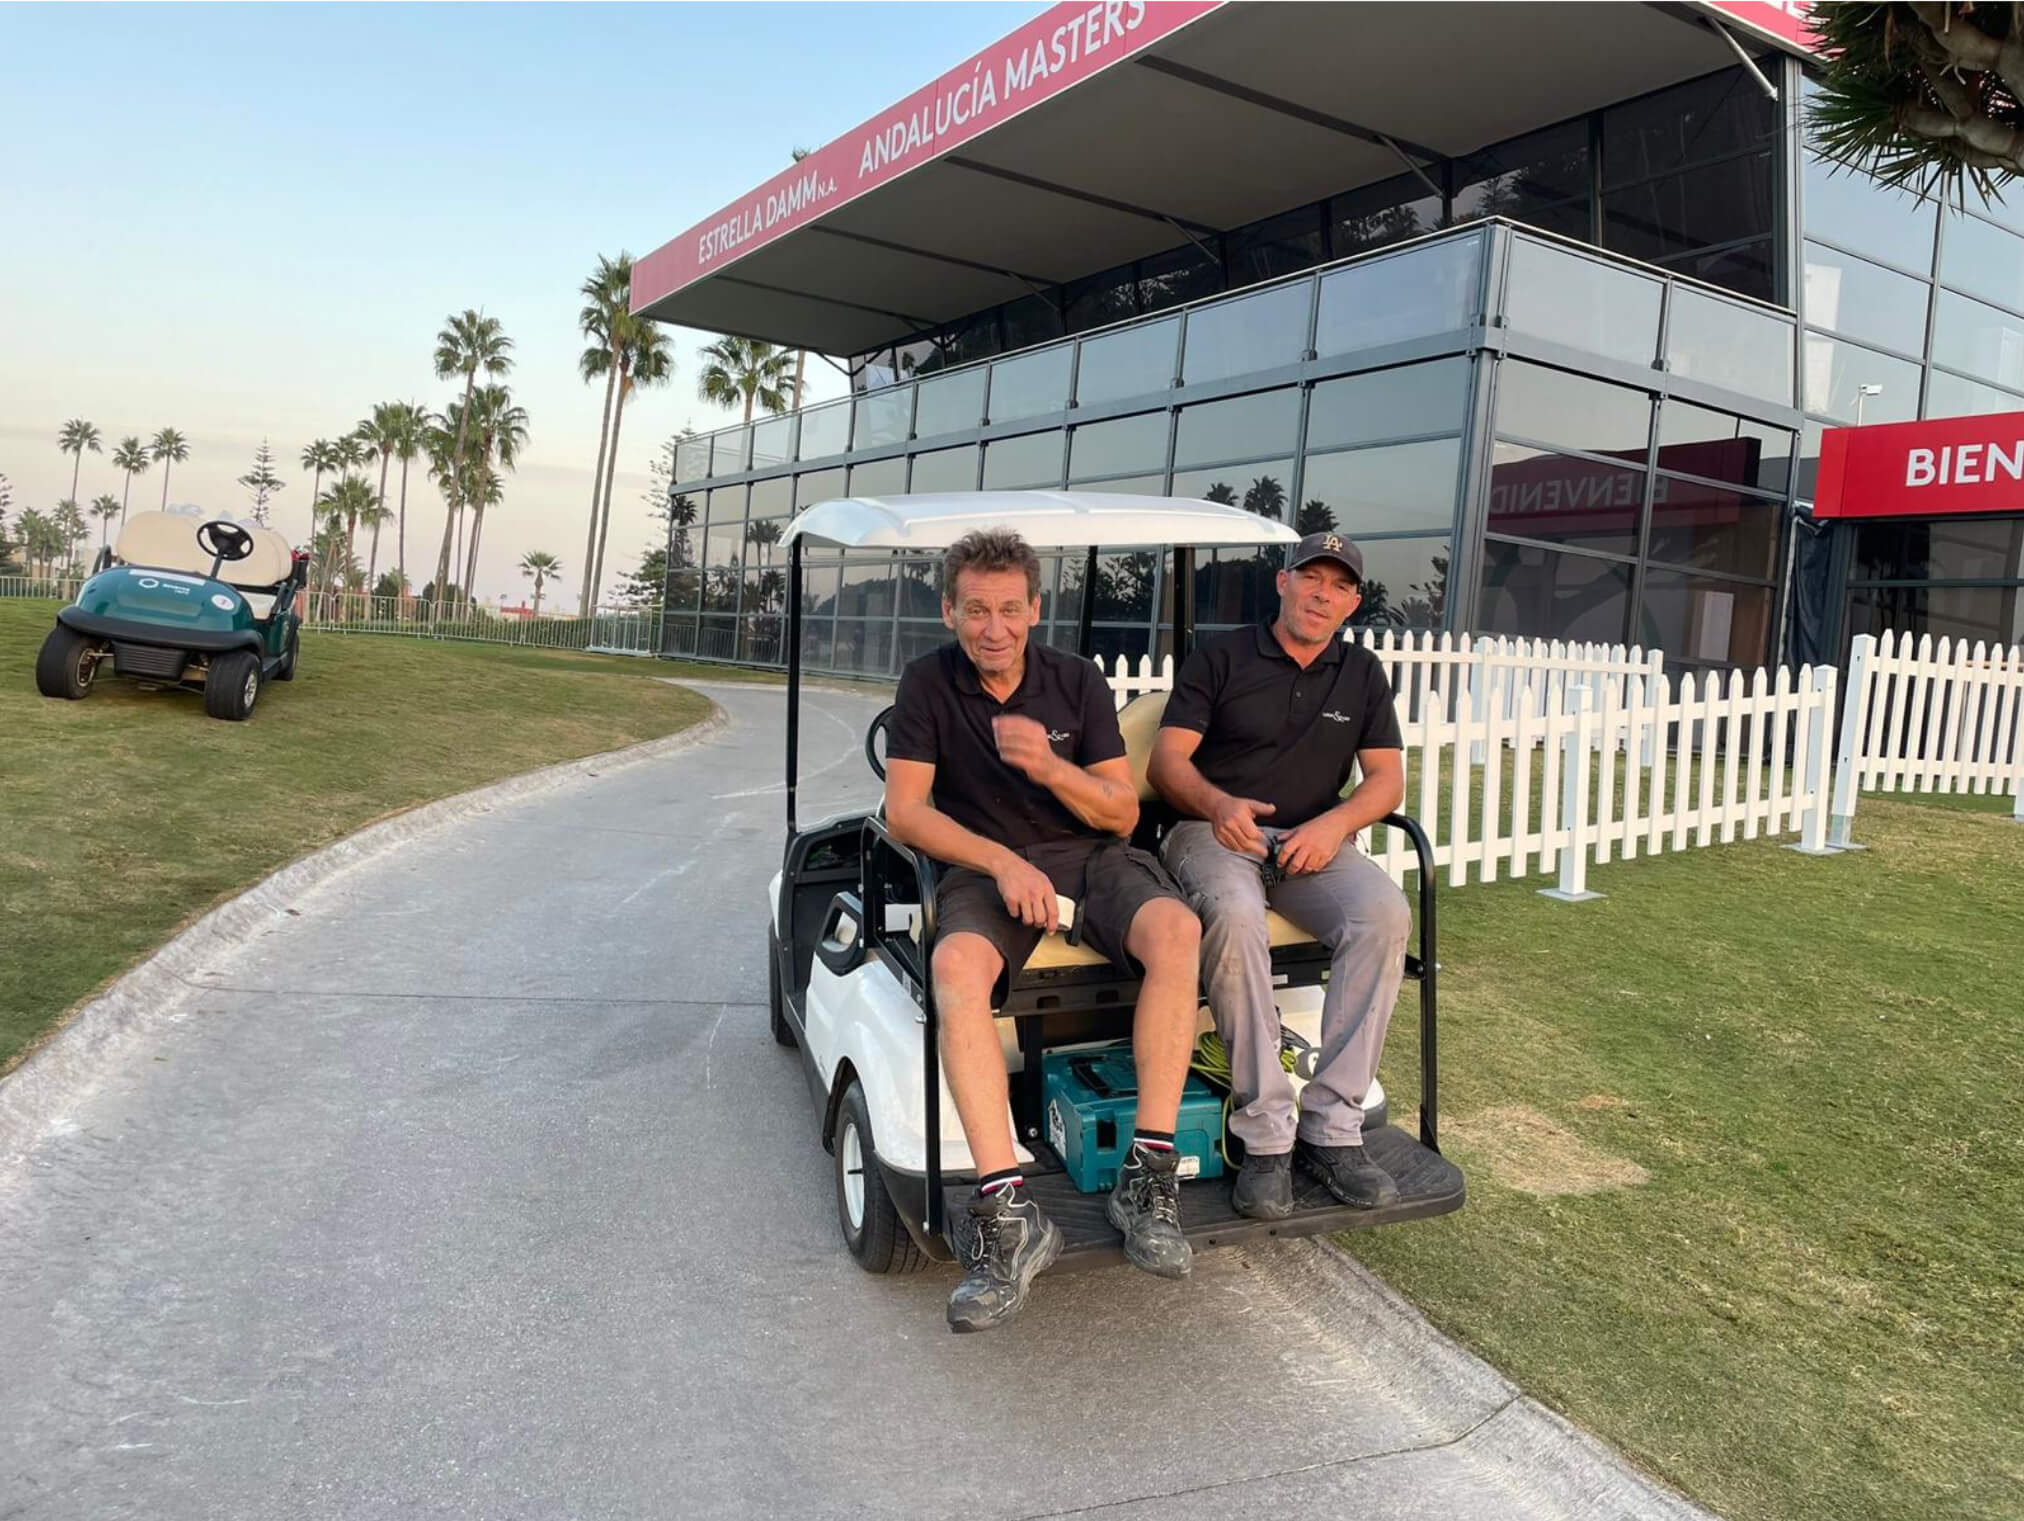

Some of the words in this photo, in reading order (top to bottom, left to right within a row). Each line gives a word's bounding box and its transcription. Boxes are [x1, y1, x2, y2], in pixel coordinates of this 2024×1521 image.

[698, 203, 763, 264] ESTRELLA
[765, 169, 818, 229] DAMM
[858, 59, 998, 179] ANDALUCÍA
[1003, 1, 1146, 100] MASTERS
[1905, 439, 2024, 488] BIEN
[1322, 532, 1343, 552] LA
